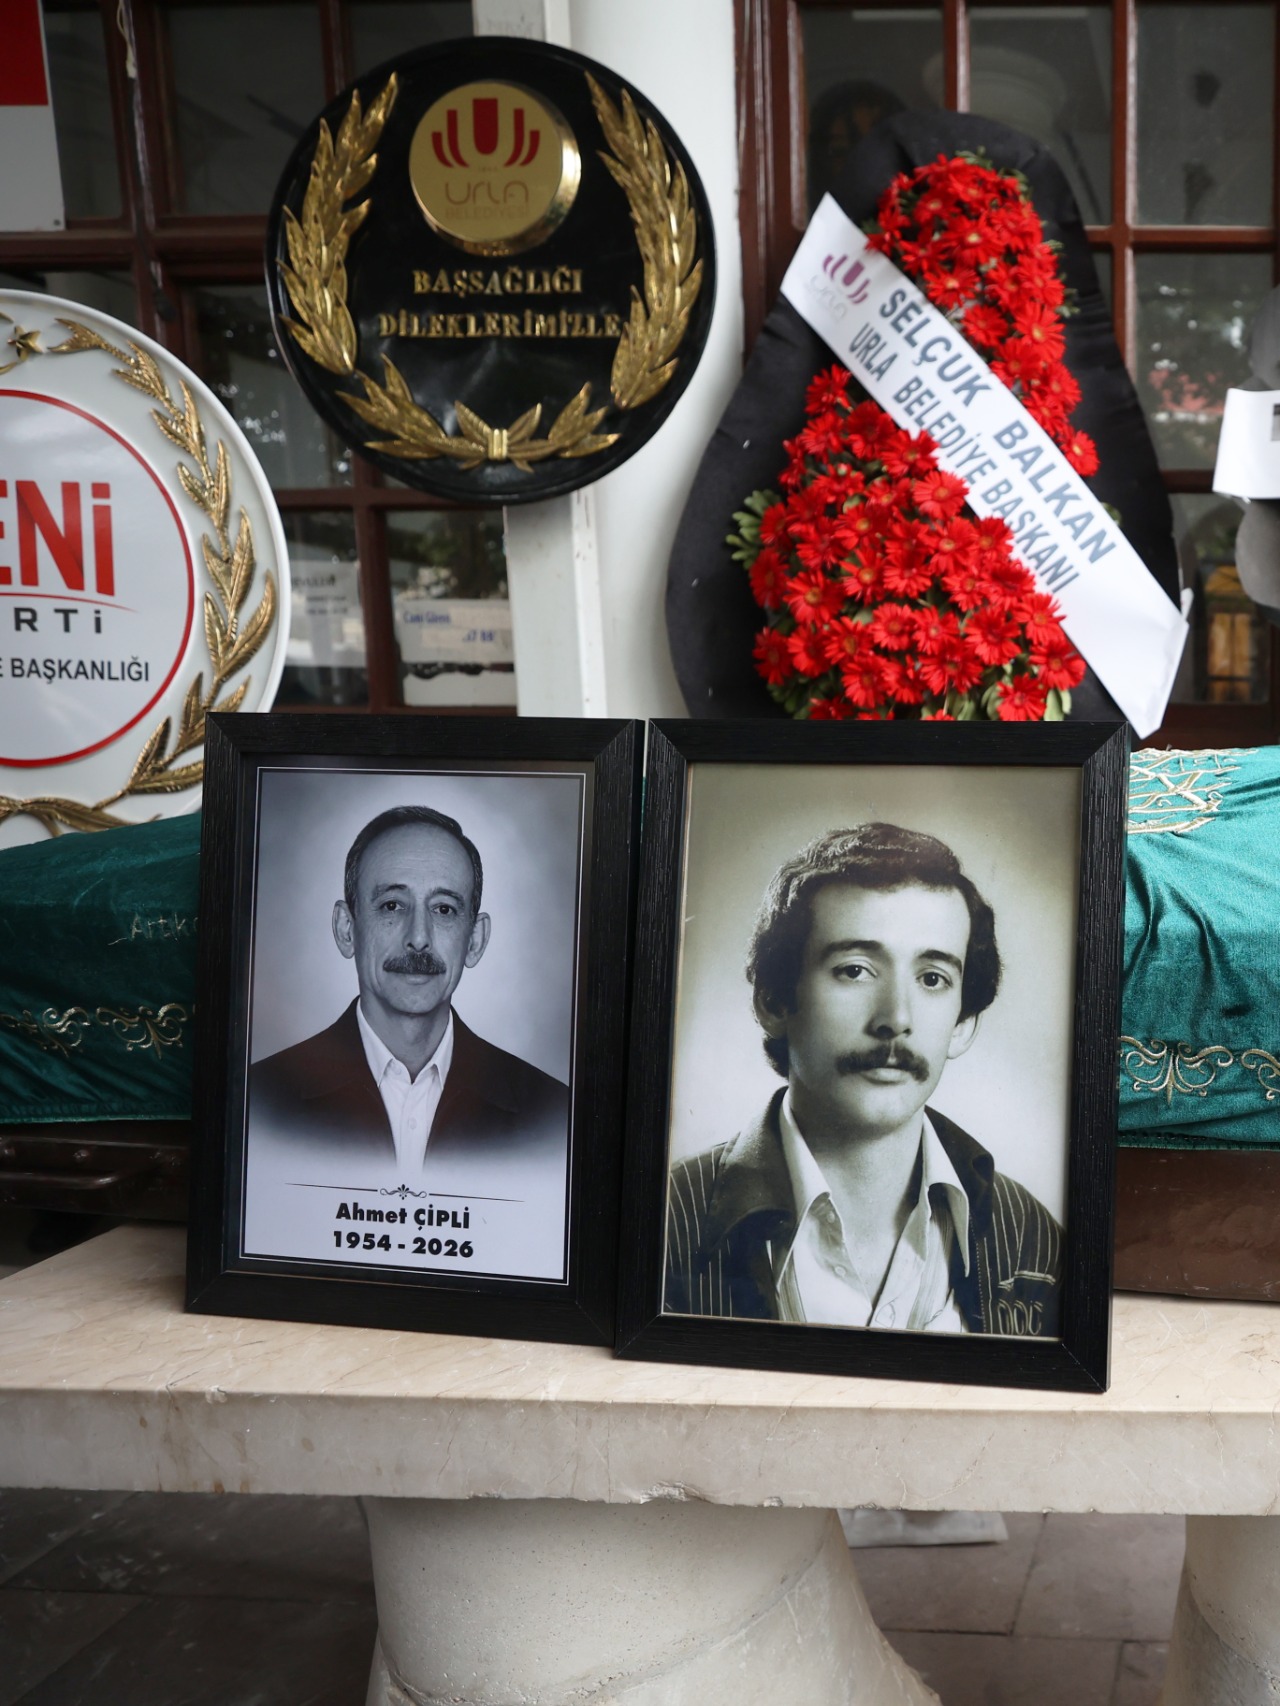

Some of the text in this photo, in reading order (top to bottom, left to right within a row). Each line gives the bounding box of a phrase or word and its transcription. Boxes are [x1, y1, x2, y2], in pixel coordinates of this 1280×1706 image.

[412, 265, 583, 298] BAŞSAĞLIĞI
[378, 308, 622, 338] DİLEKLERİMİZLE
[879, 287, 1117, 565] SELÇUK BALKAN
[848, 321, 1080, 594] URLA BELEDİYE BAŞKANI
[11, 655, 150, 685] BAŞKANLIĞI
[336, 1202, 471, 1231] Ahmet ÇİPLİ
[333, 1230, 392, 1252] 1954
[411, 1236, 474, 1259] 2026
